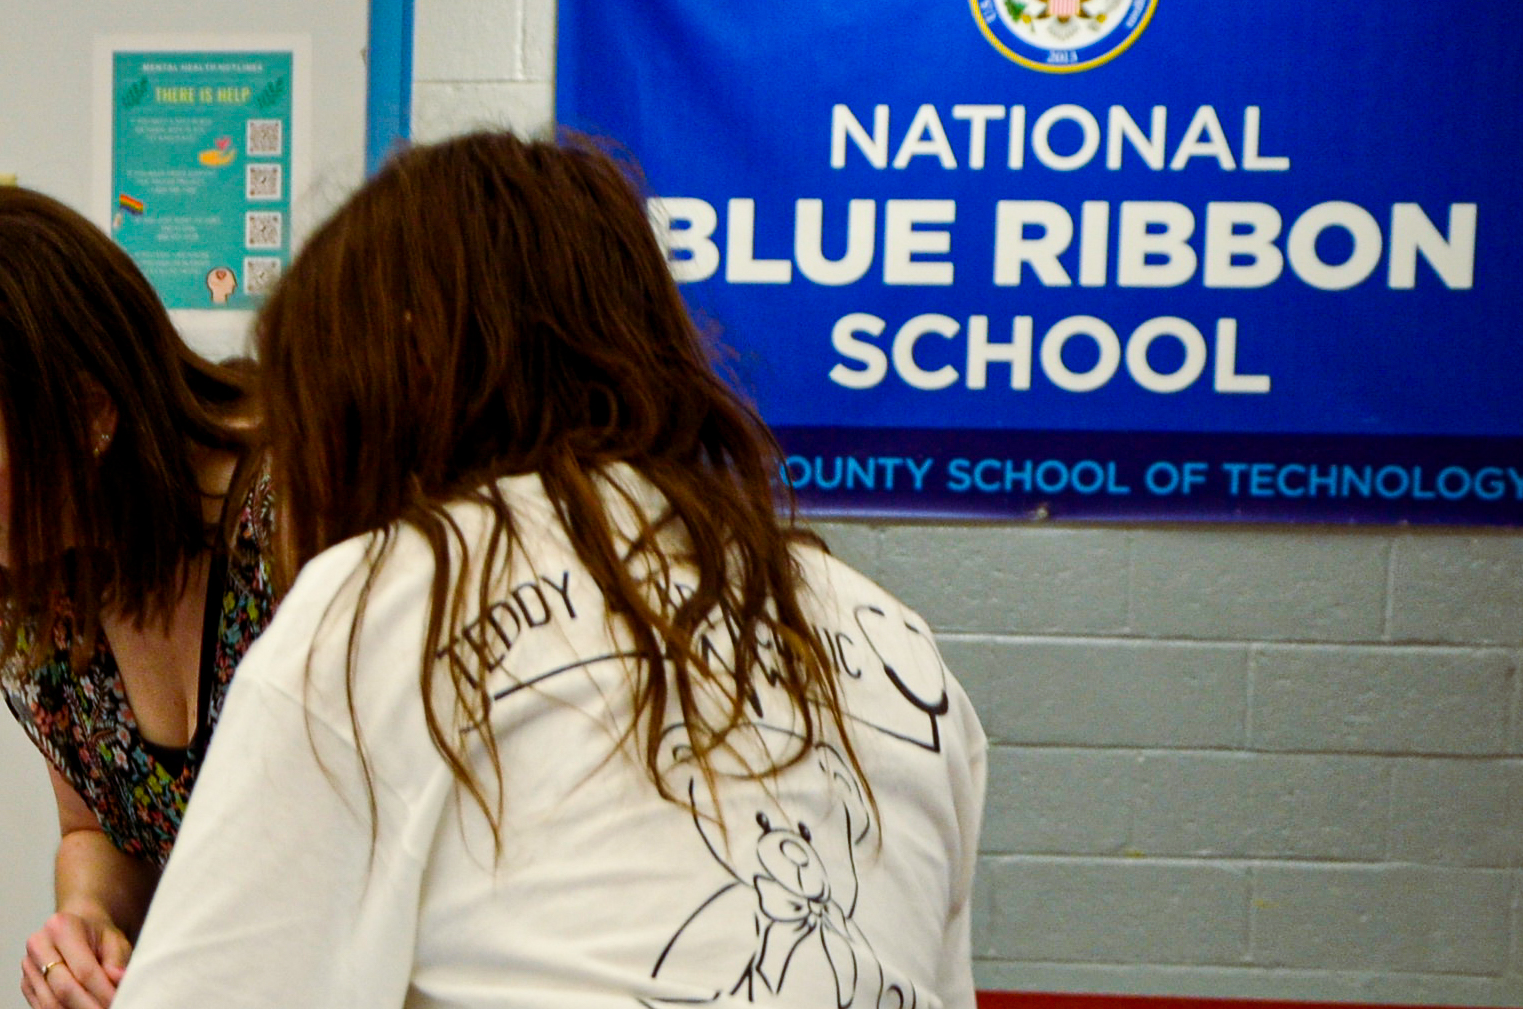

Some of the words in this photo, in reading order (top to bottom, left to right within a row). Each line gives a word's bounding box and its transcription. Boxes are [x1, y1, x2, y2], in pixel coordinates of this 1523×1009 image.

[155, 86, 194, 103] THERE
[199, 86, 214, 103] IS
[218, 86, 252, 103] HELP
[830, 103, 1290, 171] NATIONAL
[646, 197, 956, 286] BLUE
[994, 199, 1477, 290] RIBBON
[829, 313, 1270, 393] SCHOOL
[779, 454, 935, 490] OUNTY
[947, 457, 1130, 494] SCHOOL
[1145, 461, 1209, 495] OF
[1223, 463, 1523, 499] TECHNOLOGY
[436, 571, 577, 690] TEDDY
